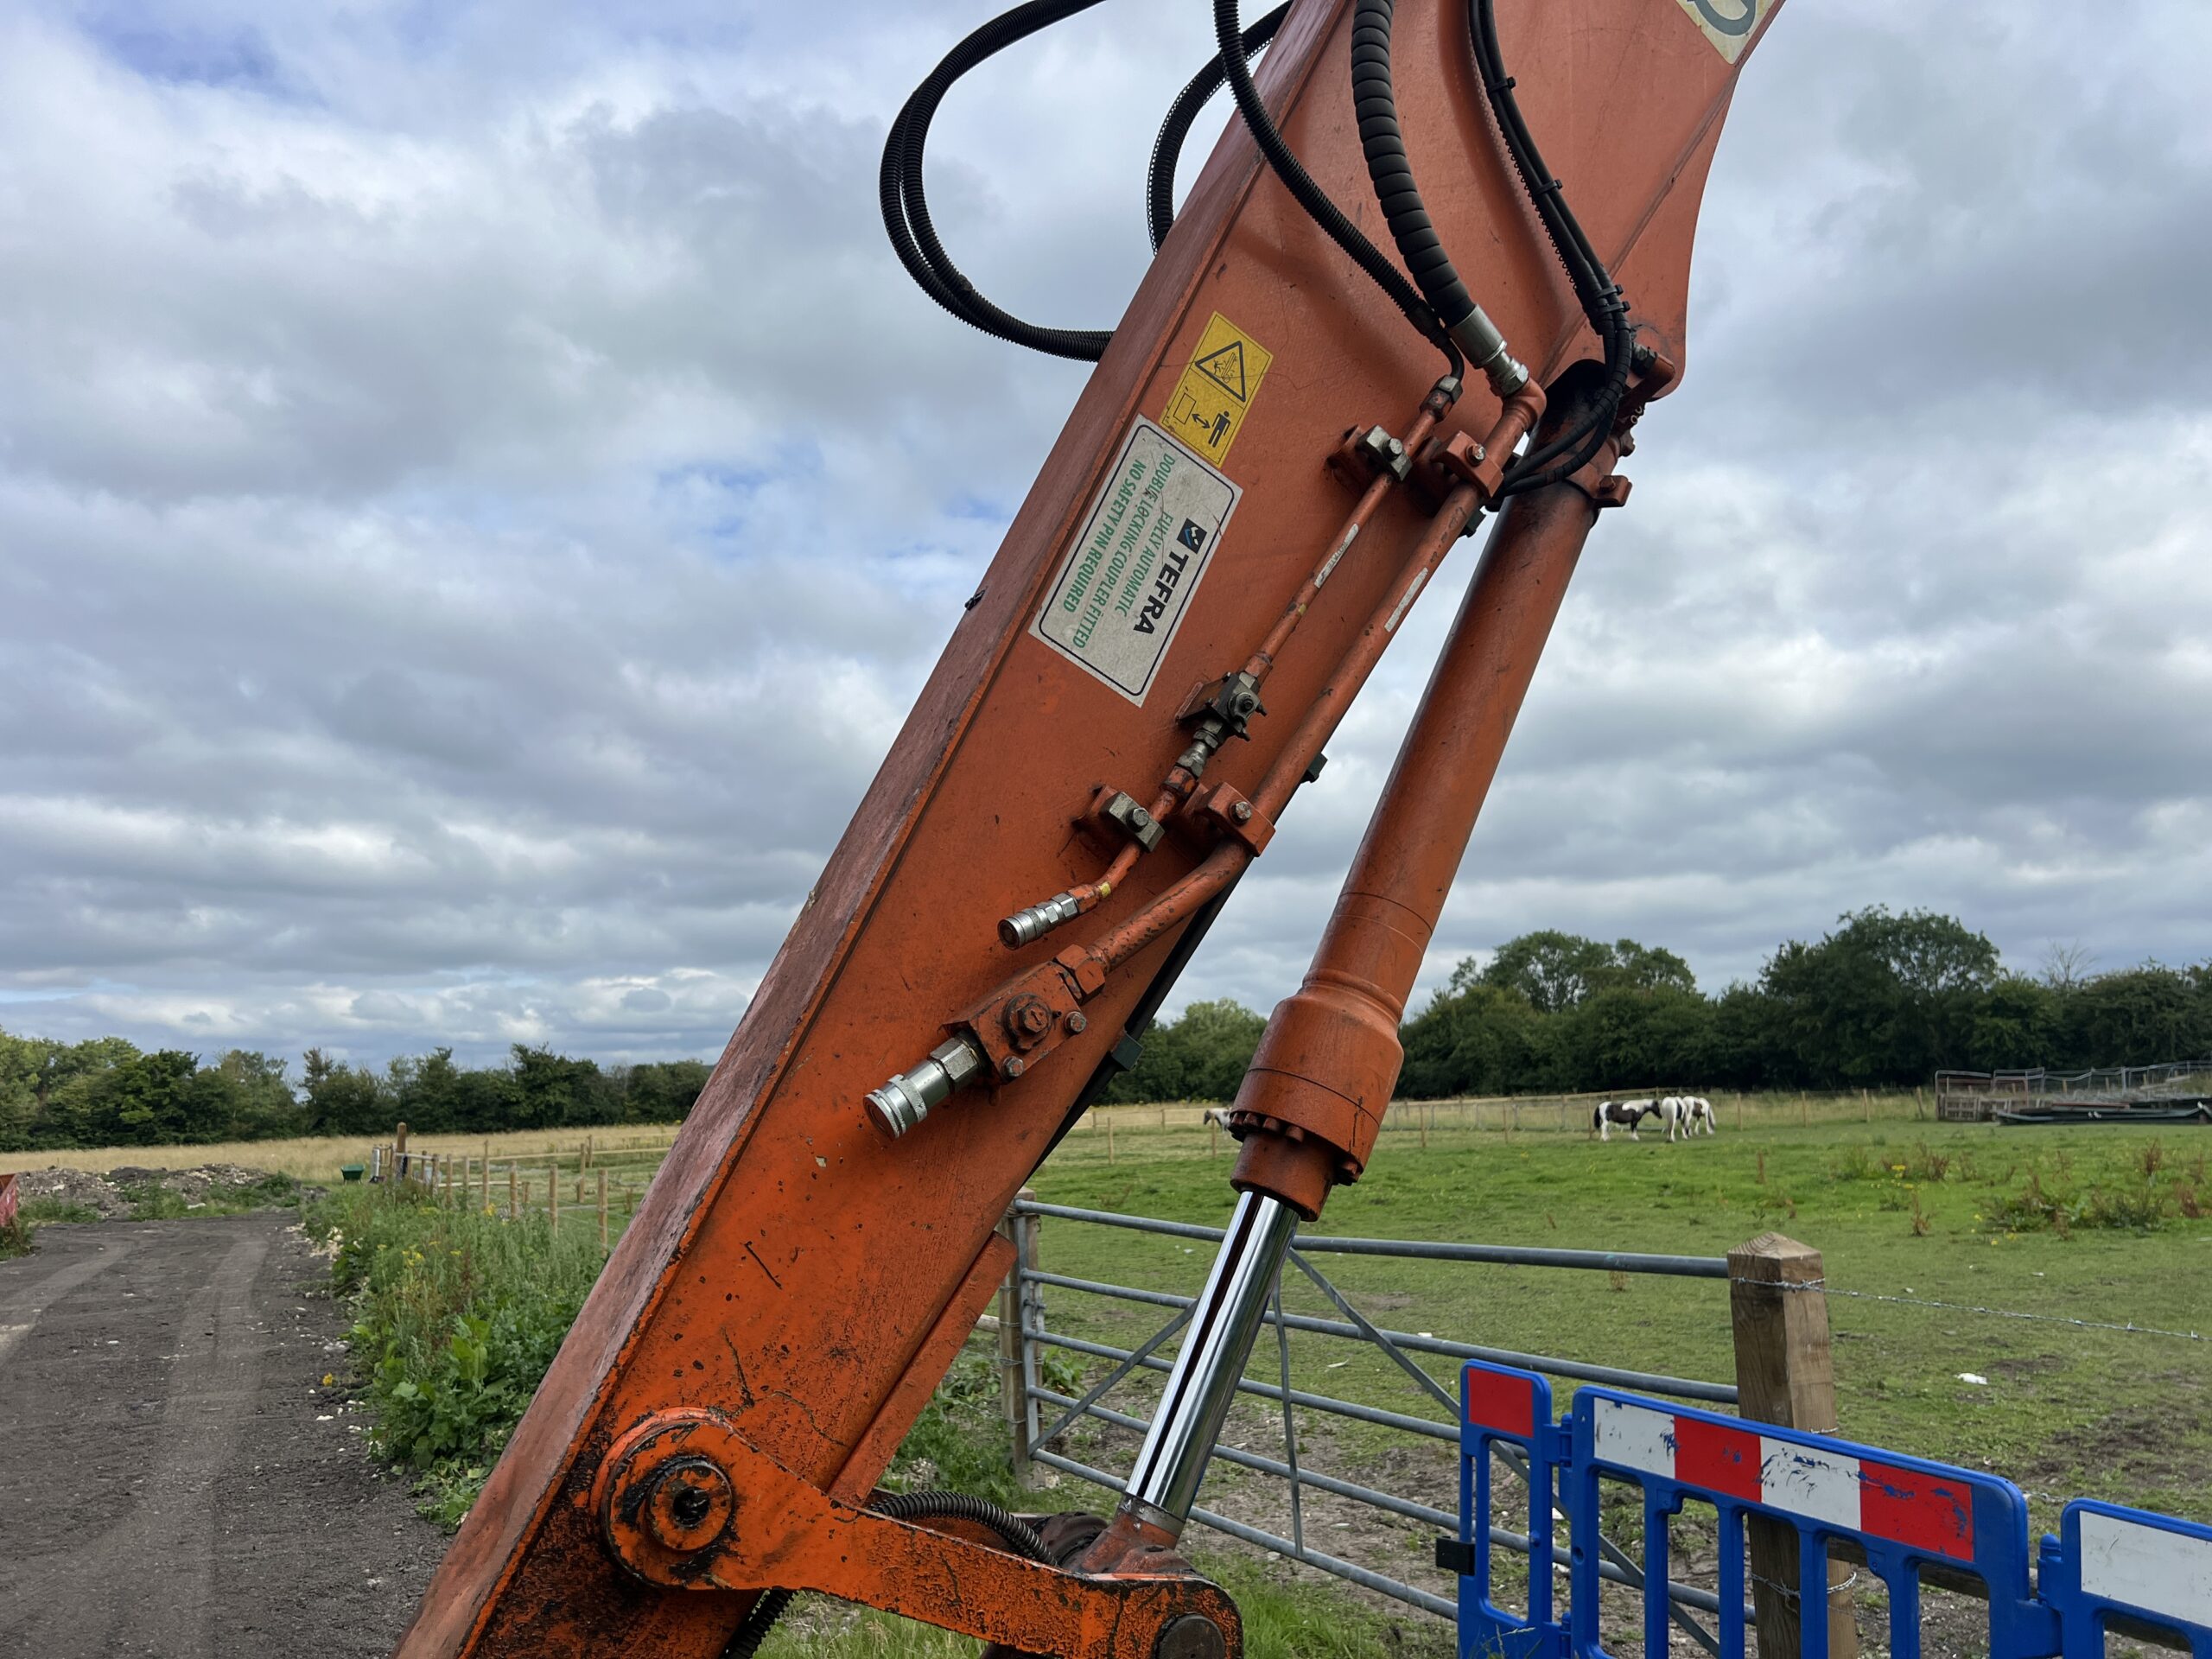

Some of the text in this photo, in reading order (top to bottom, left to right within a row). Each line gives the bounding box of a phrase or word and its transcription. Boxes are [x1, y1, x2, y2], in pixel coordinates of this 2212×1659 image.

[1063, 460, 1147, 613] NO SAFETY PIN REQUIRED
[1072, 453, 1176, 649] DOUBLE LOCKING COUPLER FITTED
[1115, 512, 1173, 617] FULLY AUTOMATIC
[1133, 551, 1189, 635] TEFRA
